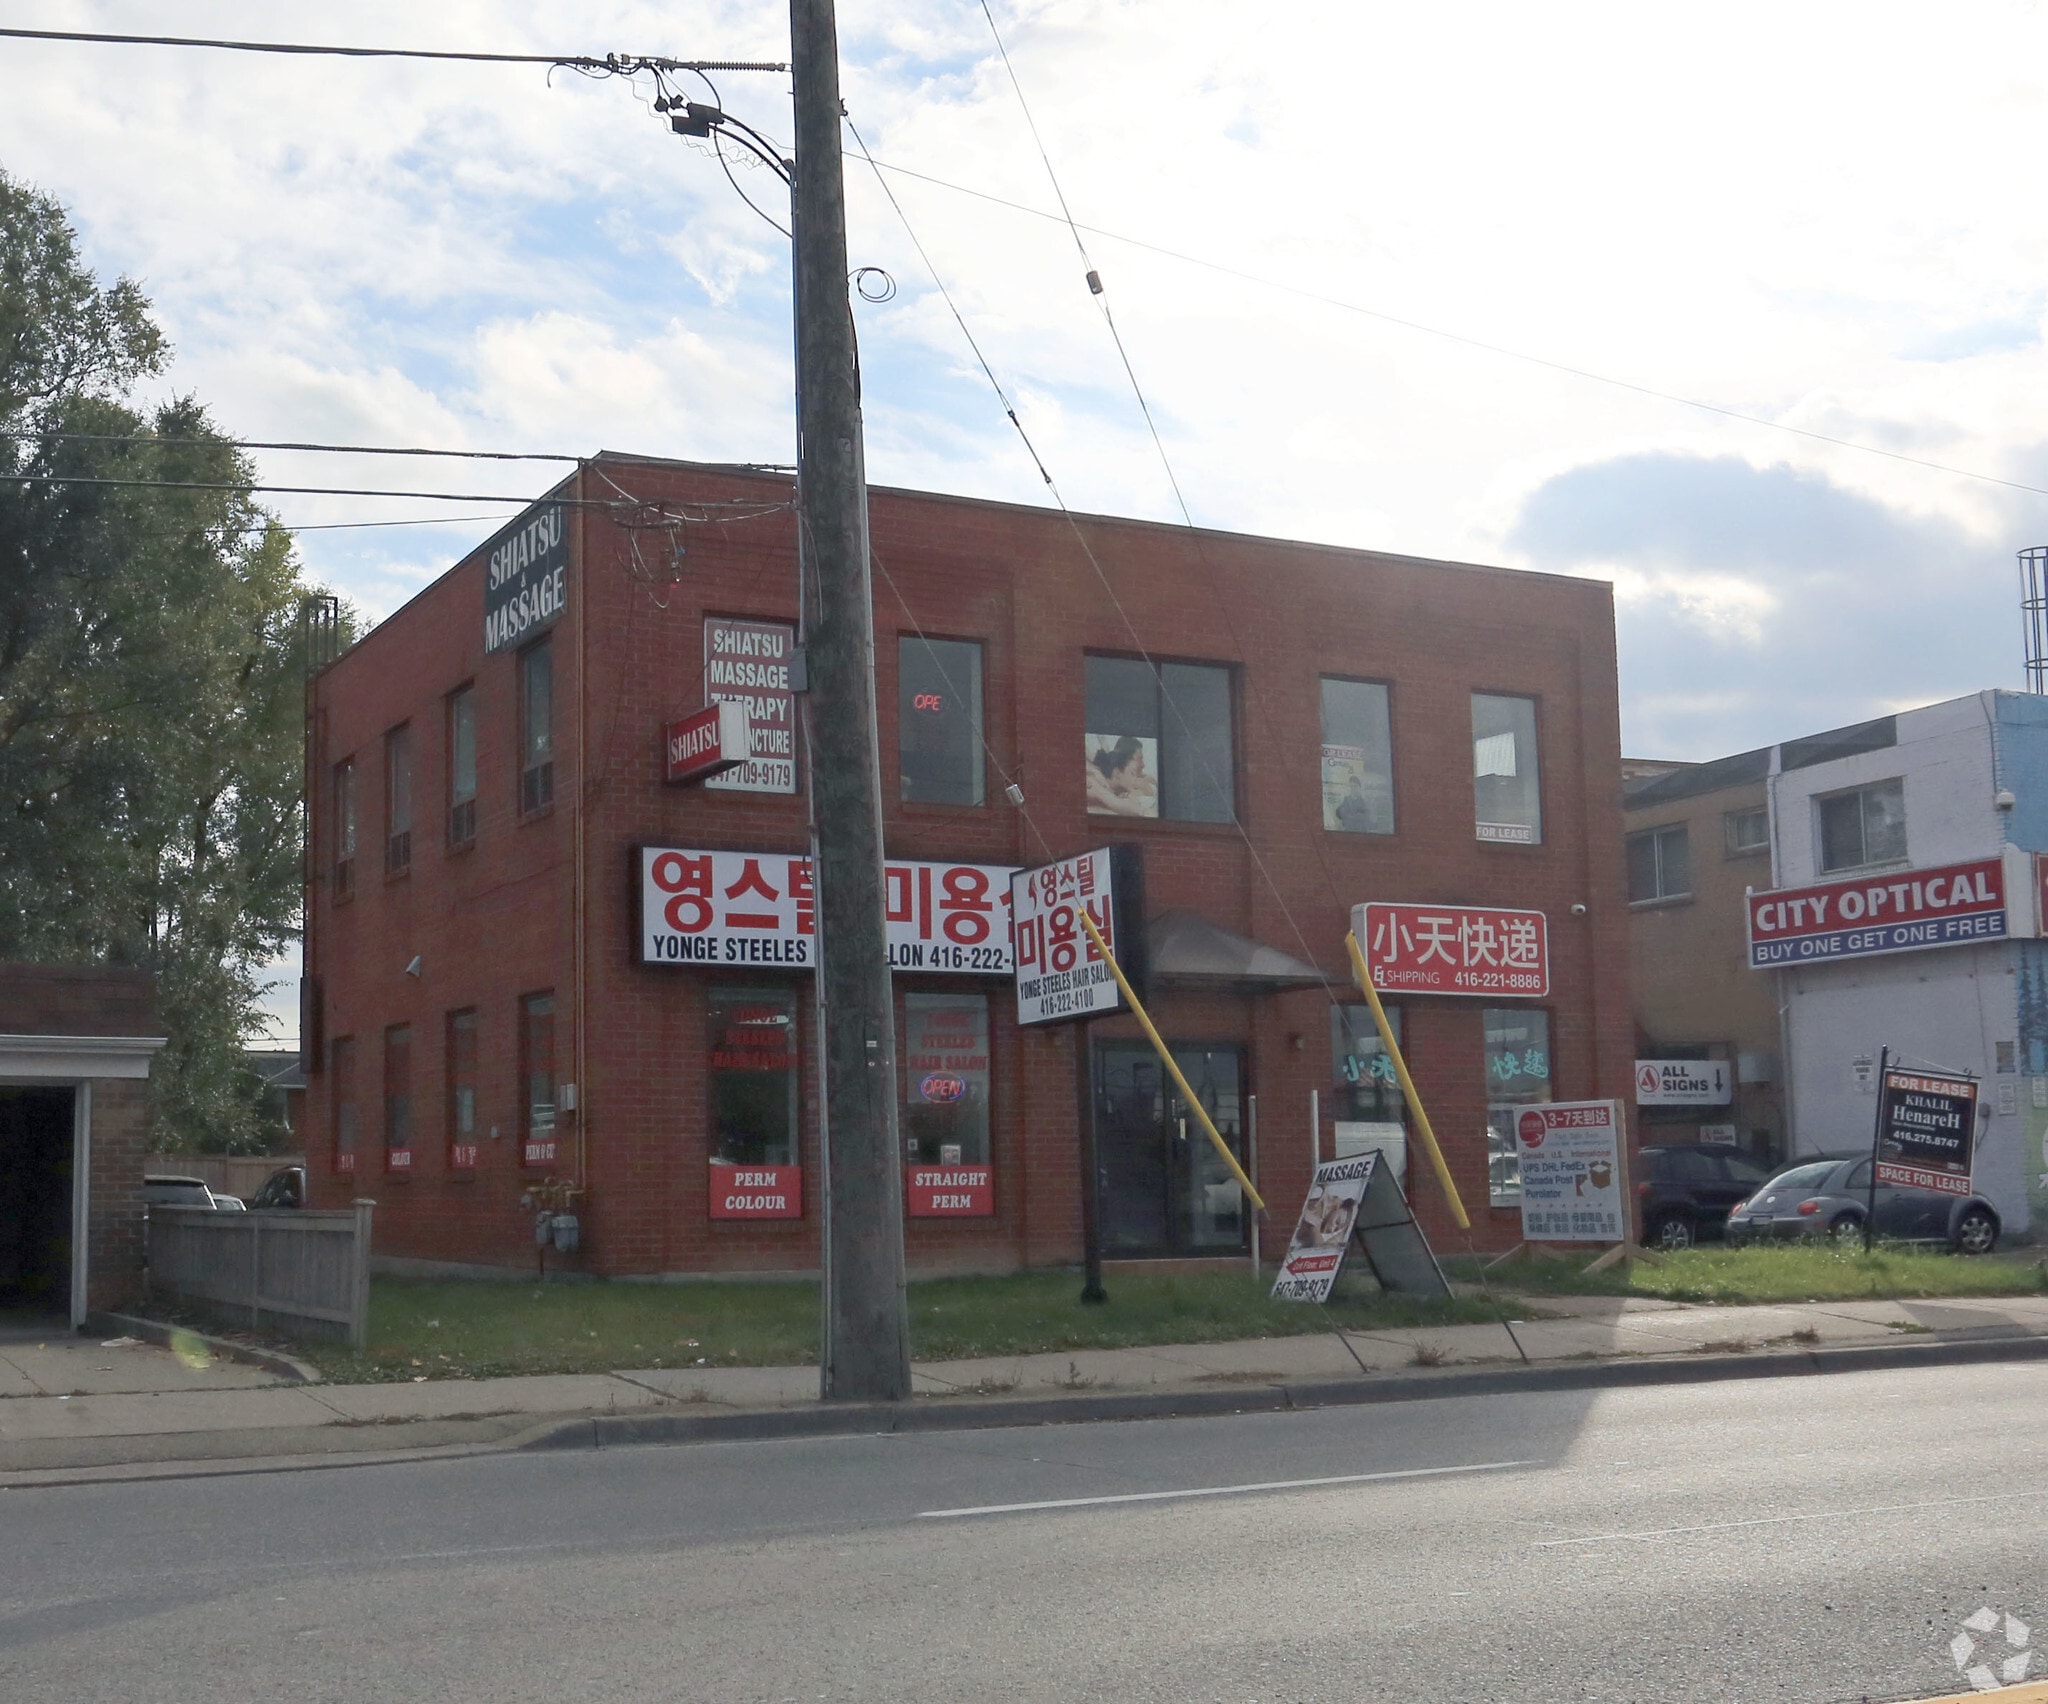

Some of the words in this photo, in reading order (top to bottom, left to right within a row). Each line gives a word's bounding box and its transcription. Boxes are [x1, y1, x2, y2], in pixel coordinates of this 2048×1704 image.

[490, 505, 561, 590] SHIATSU
[485, 566, 565, 654] MASSAGE
[713, 629, 784, 658] SHIATSU
[711, 660, 789, 690] MASSAGE
[711, 693, 788, 722] RAPY
[671, 720, 721, 764] SHIATSU
[750, 728, 790, 754] NCTURE
[1476, 826, 1497, 838] FOR
[1498, 828, 1530, 840] LEASE
[1040, 855, 1095, 907] 영스틸
[884, 866, 1013, 945] 미용
[1756, 895, 1829, 932] CITY
[1838, 871, 1997, 920] OPTICAL
[1373, 912, 1540, 969] 小天快递
[1756, 943, 1794, 962] BUY
[1800, 937, 1841, 956] ONE
[1848, 931, 1887, 950] GET
[1893, 924, 1938, 944] ONE
[1945, 915, 2001, 938] FREE
[653, 935, 718, 960] YONGE
[725, 938, 807, 963] STEELES
[889, 943, 924, 967] LON
[930, 946, 1015, 970] 416-222-
[1020, 977, 1042, 1001] YONGE
[1042, 972, 1071, 996] STEELES
[1072, 968, 1090, 989] HAIR
[1387, 970, 1440, 984] SHIPPING
[1455, 971, 1541, 989] 416-221-8886
[1040, 988, 1094, 1016] 416-222-4100
[1662, 1066, 1689, 1077] ALL
[923, 1078, 962, 1098] OPEN
[1662, 1080, 1709, 1091] SIGNS
[1890, 1075, 1918, 1091] FOR
[1923, 1079, 1969, 1097] LEASE
[1905, 1095, 1953, 1111] KHALIL
[1548, 1108, 1608, 1127] 3-7天到达
[1893, 1105, 1960, 1129] HenareH
[1893, 1130, 1960, 1148] 416.275.8747
[1316, 1160, 1372, 1183] MASSAGE
[1523, 1163, 1540, 1173] UPS
[1542, 1162, 1559, 1172] DHL
[1561, 1161, 1586, 1171] FedEx
[734, 1173, 776, 1187] PERM
[915, 1173, 987, 1186] STRAIGHT
[1524, 1175, 1553, 1185] Canada
[1555, 1174, 1573, 1185] Post
[1879, 1167, 1911, 1182] SPACE
[1914, 1172, 1934, 1187] FOR
[1936, 1177, 1968, 1193] LEASE
[725, 1195, 786, 1210] COLOUR
[931, 1195, 971, 1208] PERM
